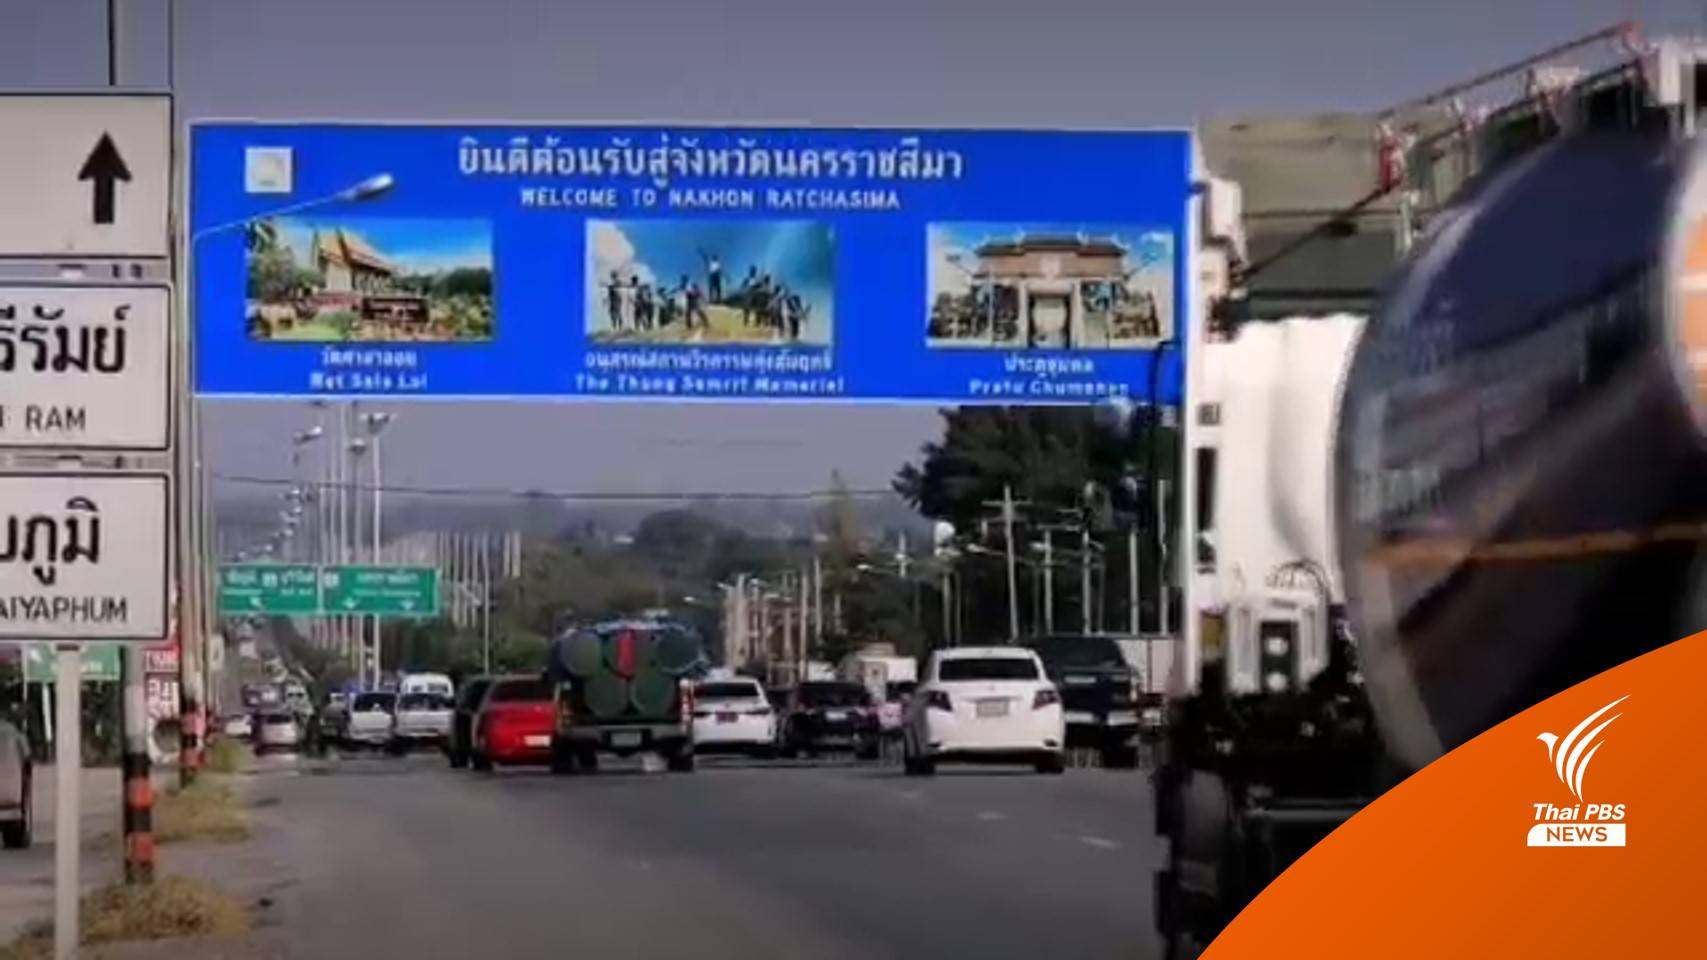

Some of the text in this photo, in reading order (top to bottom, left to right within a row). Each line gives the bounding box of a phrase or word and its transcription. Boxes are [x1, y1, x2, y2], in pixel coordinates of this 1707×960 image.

[520, 188, 901, 210] WELCOME TO NAKHON RATCHASIMA
[25, 404, 86, 431] RAM
